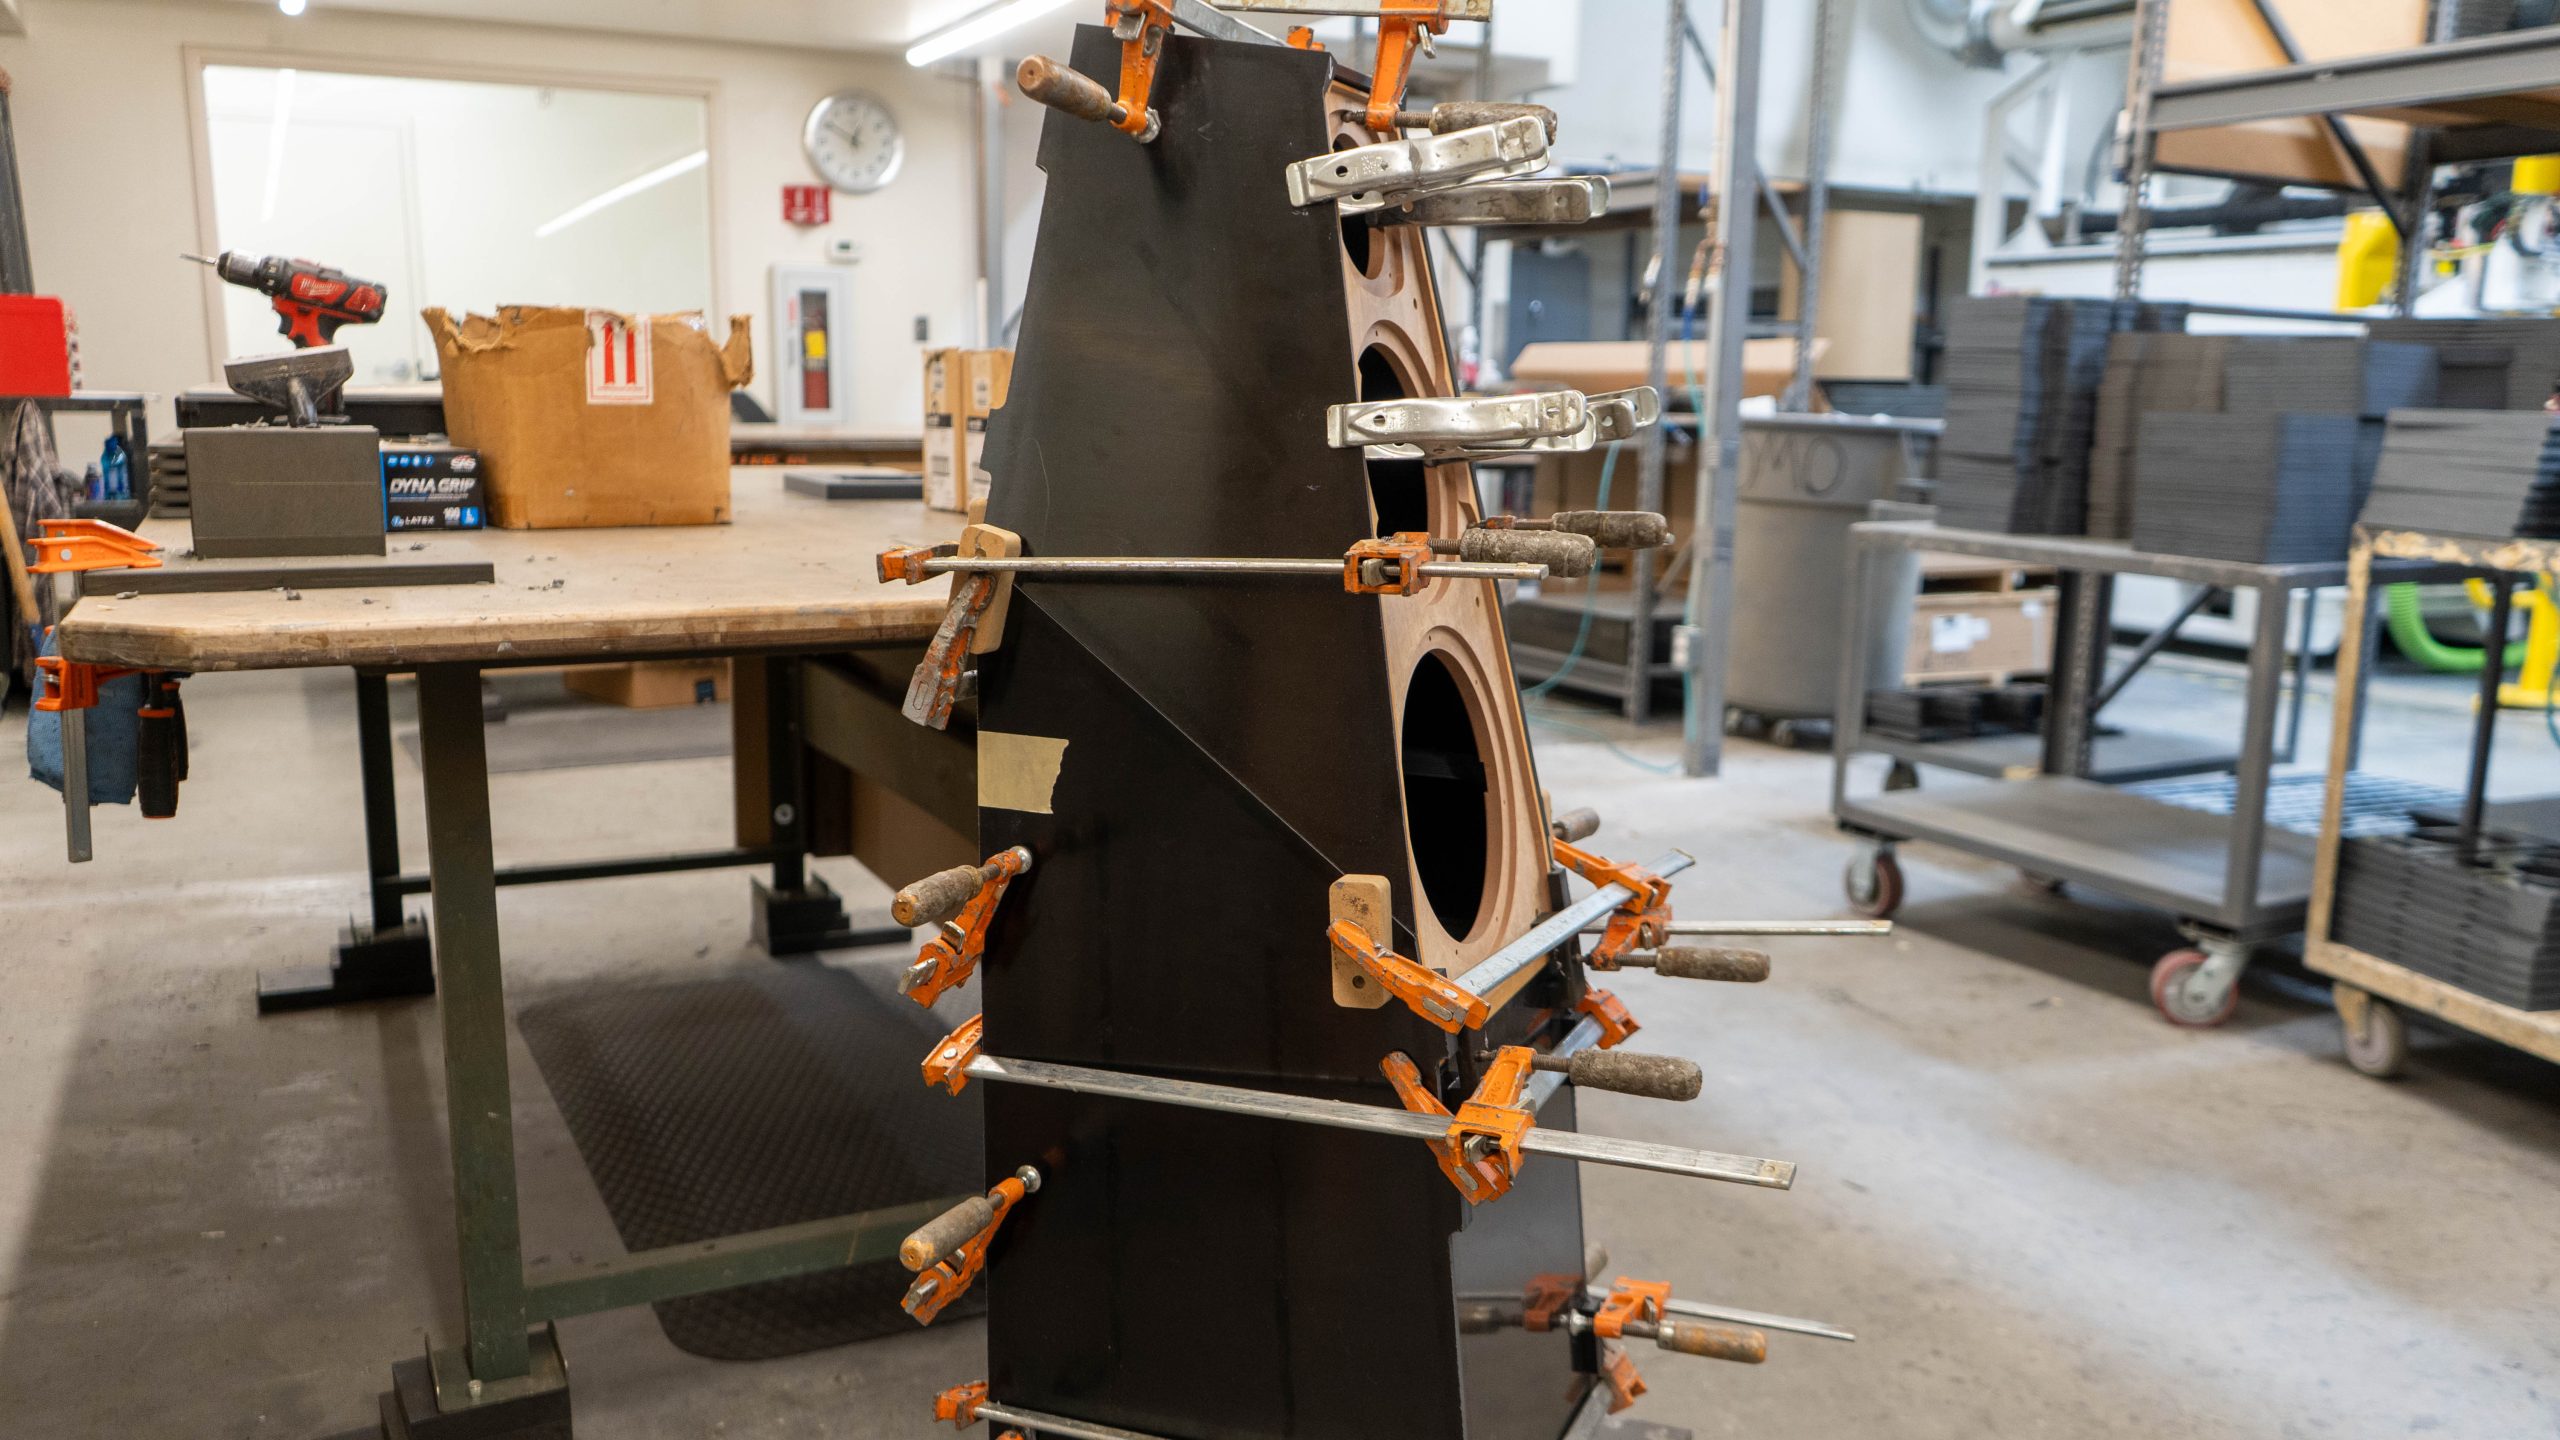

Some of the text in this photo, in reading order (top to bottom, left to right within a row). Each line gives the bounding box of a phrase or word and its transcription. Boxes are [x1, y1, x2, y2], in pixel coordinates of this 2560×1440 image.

[390, 478, 476, 493] DYNA GRIP
[405, 516, 434, 525] LATEX
